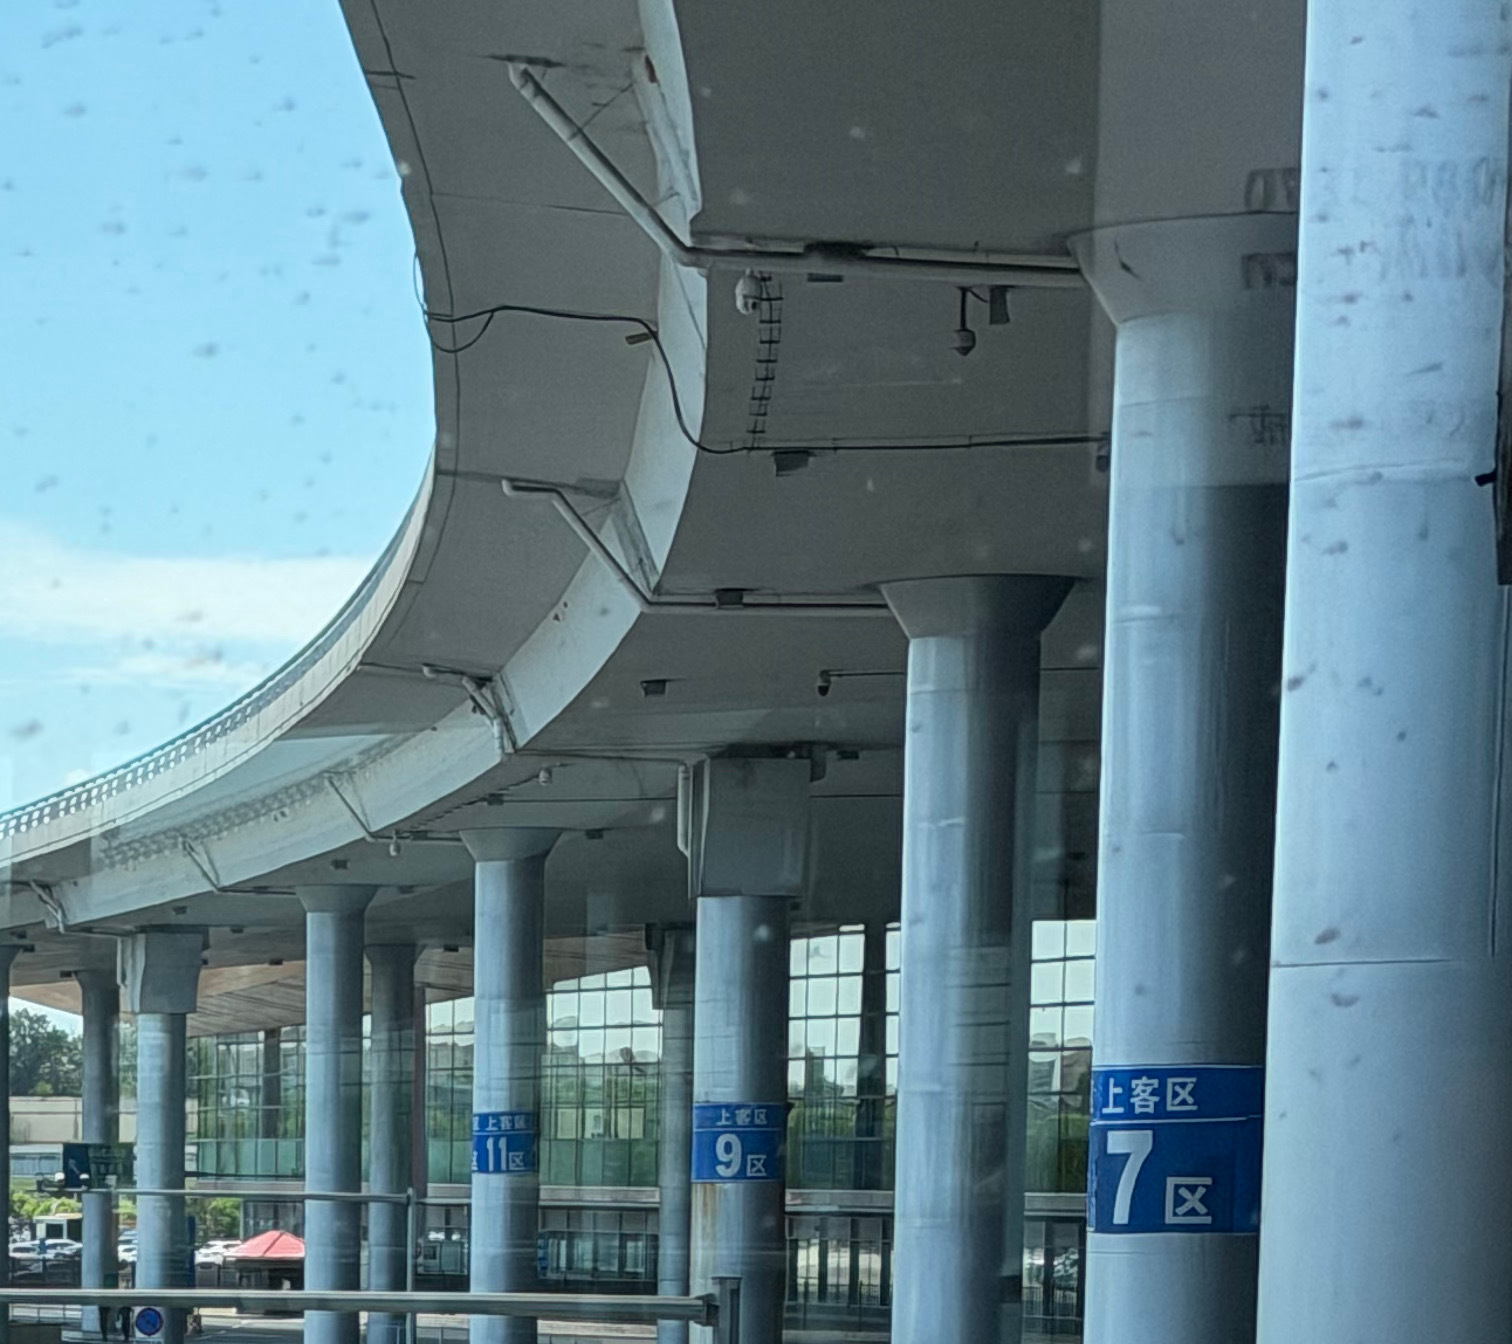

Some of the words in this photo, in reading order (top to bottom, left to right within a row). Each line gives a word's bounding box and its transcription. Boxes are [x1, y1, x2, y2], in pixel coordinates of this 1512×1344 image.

[1102, 1075, 1198, 1115] 上客区
[715, 1133, 767, 1178] 9区
[1106, 1129, 1213, 1225] 7区
